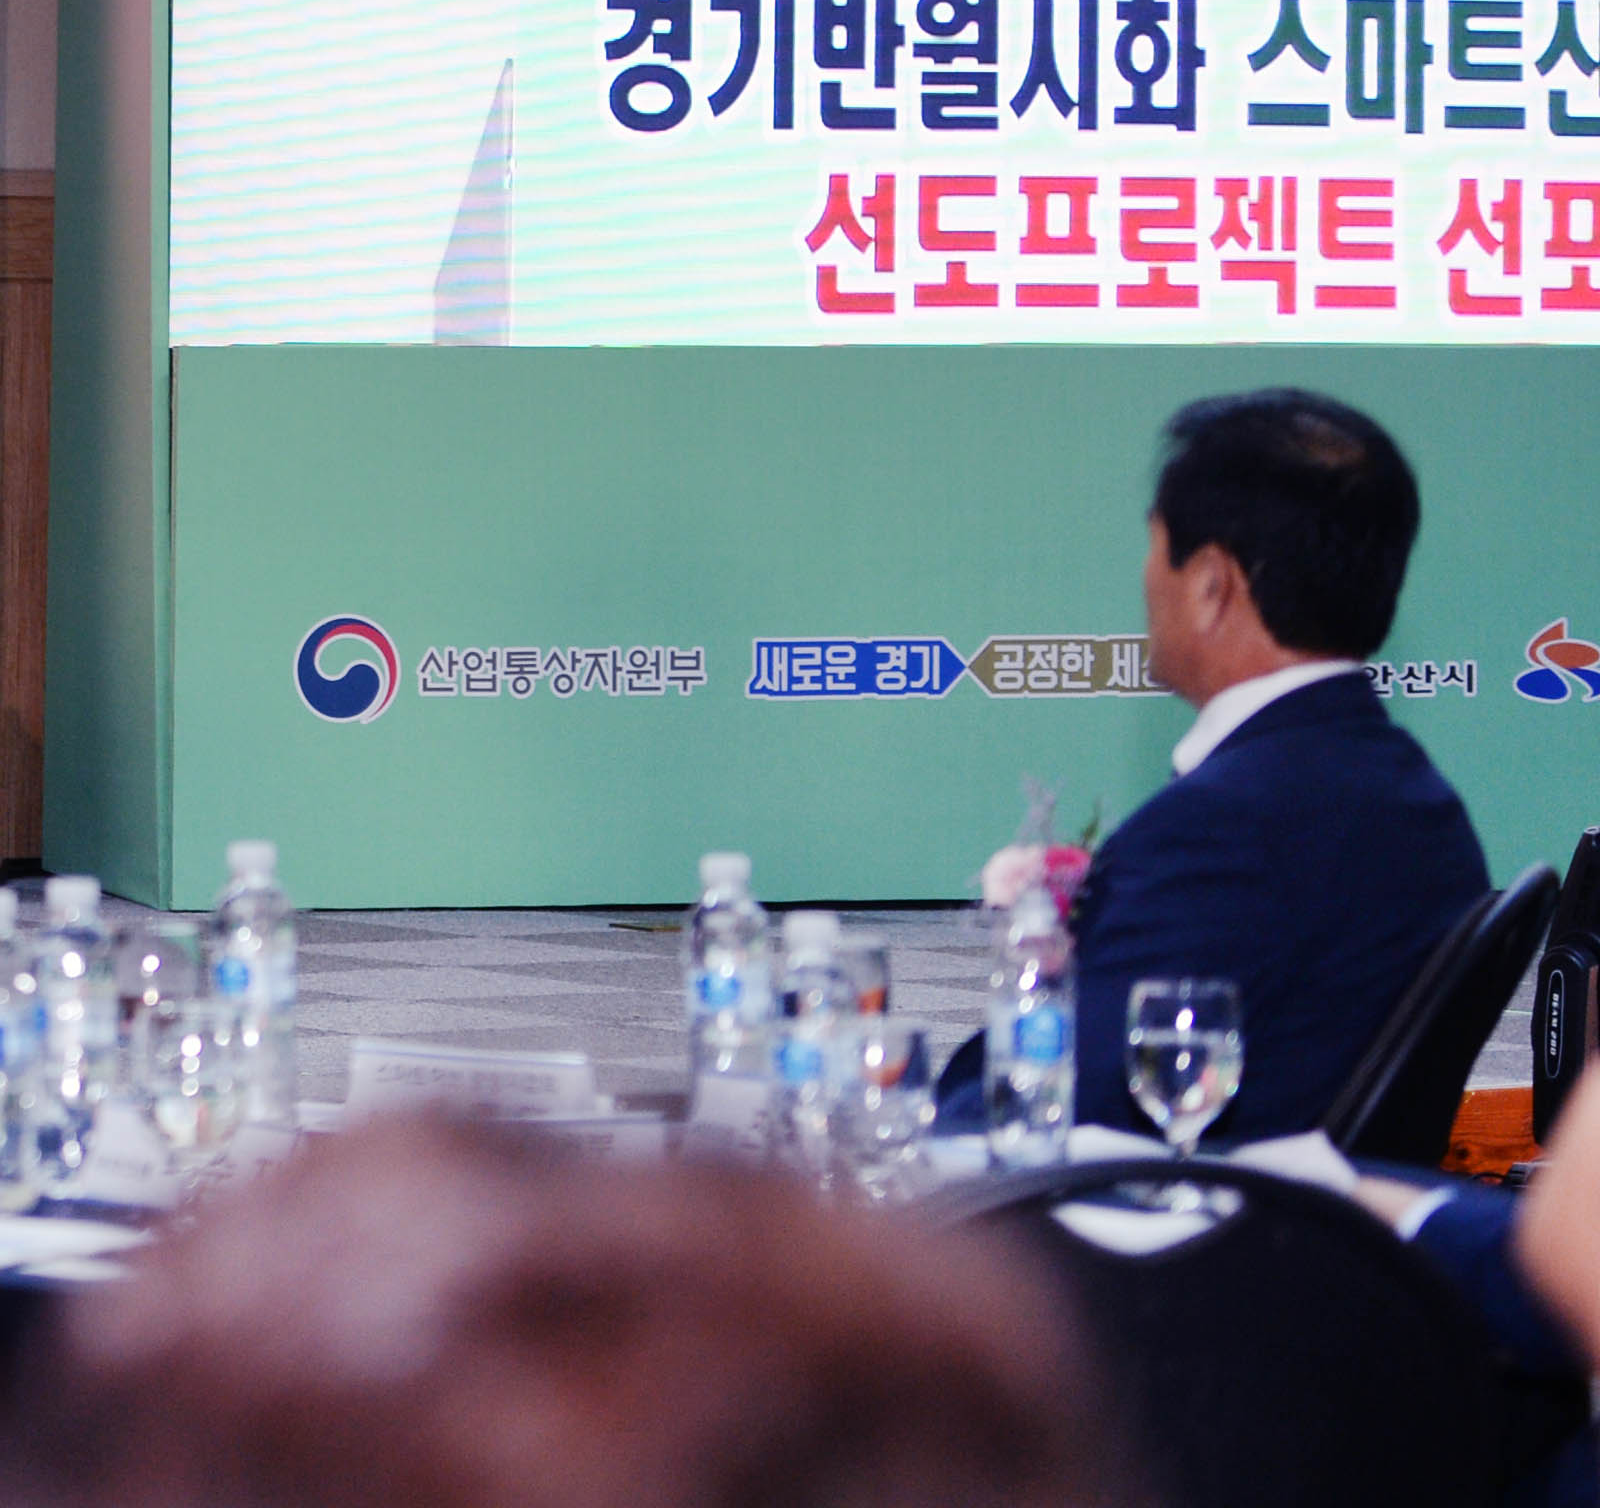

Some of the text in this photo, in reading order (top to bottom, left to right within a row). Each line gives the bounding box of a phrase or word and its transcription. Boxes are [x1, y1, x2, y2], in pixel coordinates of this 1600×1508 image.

[805, 173, 1397, 315] 선도프로젝트
[420, 649, 704, 695] 산업통상자원부
[754, 645, 941, 692] 새로운 경기
[993, 642, 1168, 690] 공정한 세
